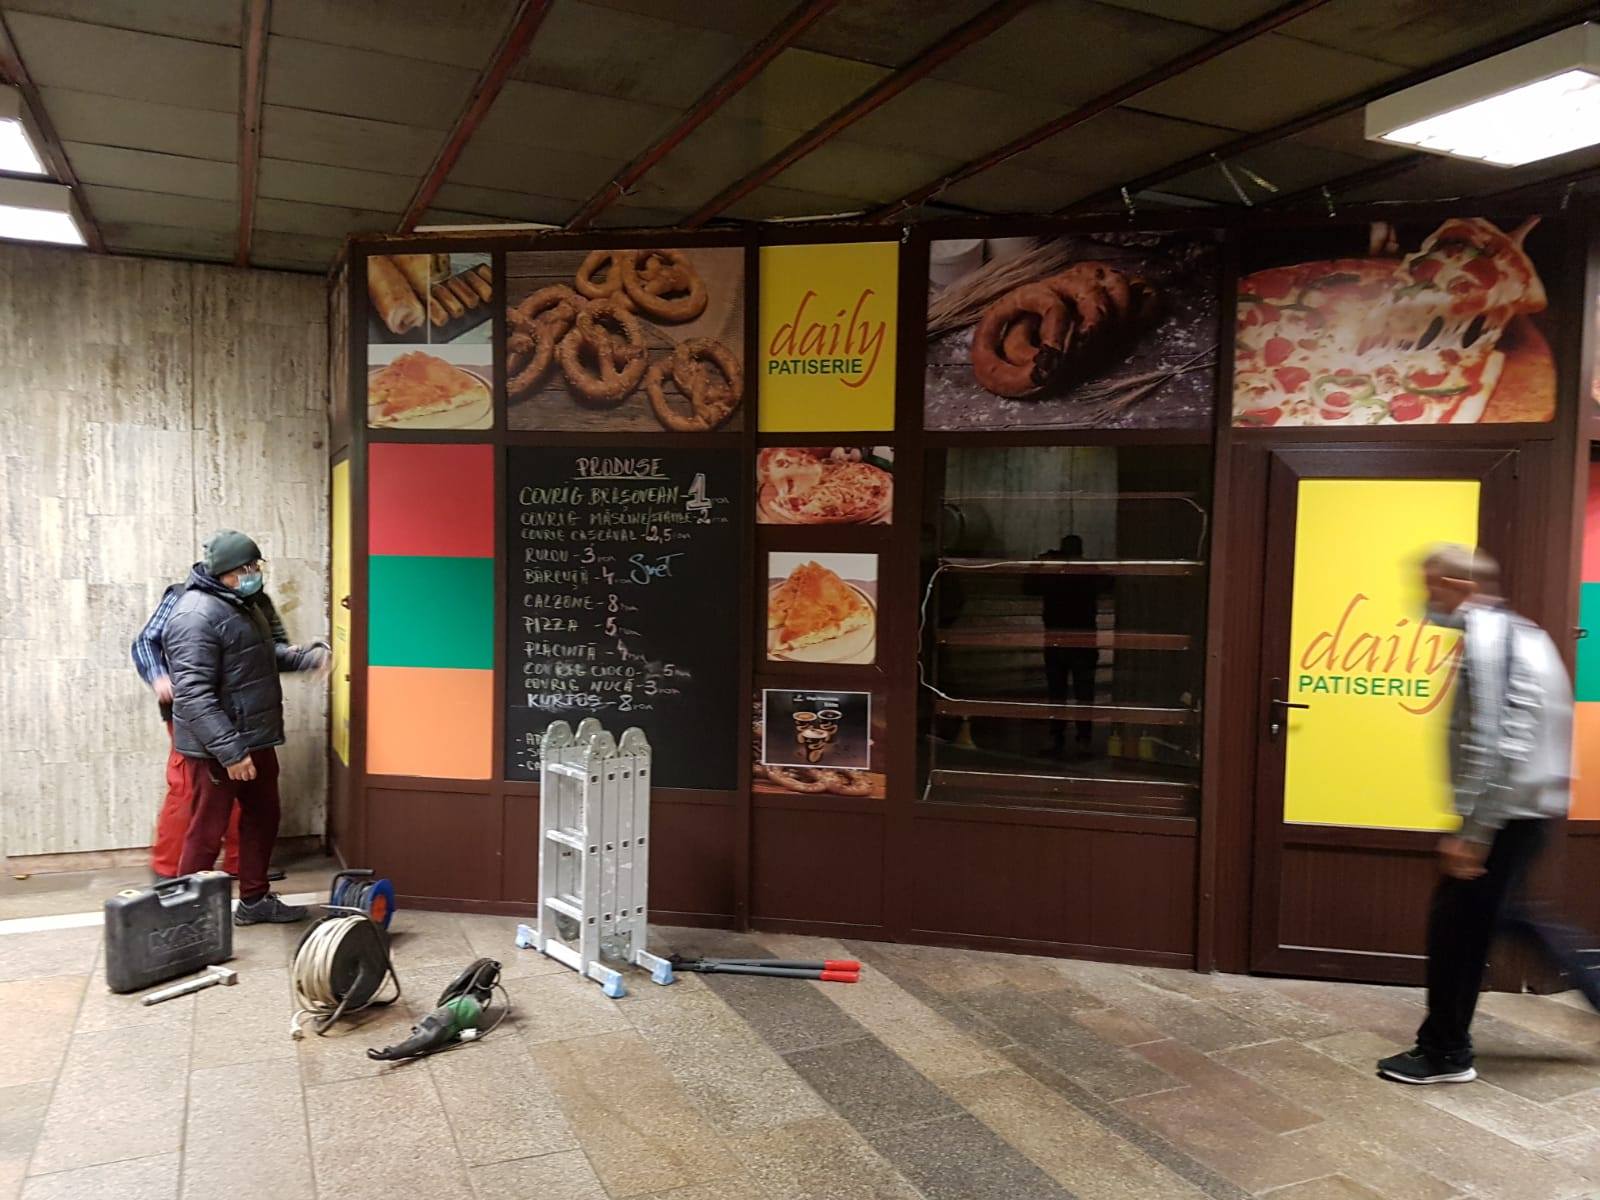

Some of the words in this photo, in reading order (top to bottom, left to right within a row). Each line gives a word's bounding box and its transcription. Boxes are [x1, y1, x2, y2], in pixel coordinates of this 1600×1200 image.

[769, 288, 886, 388] daily
[768, 359, 862, 375] PATISERIE
[575, 457, 667, 477] PRODUSE
[525, 547, 569, 563] RULOU
[523, 593, 594, 610] CALZONE
[522, 616, 580, 634] PIZZA
[1300, 593, 1464, 714] daily
[1299, 675, 1431, 698] PATISERIE
